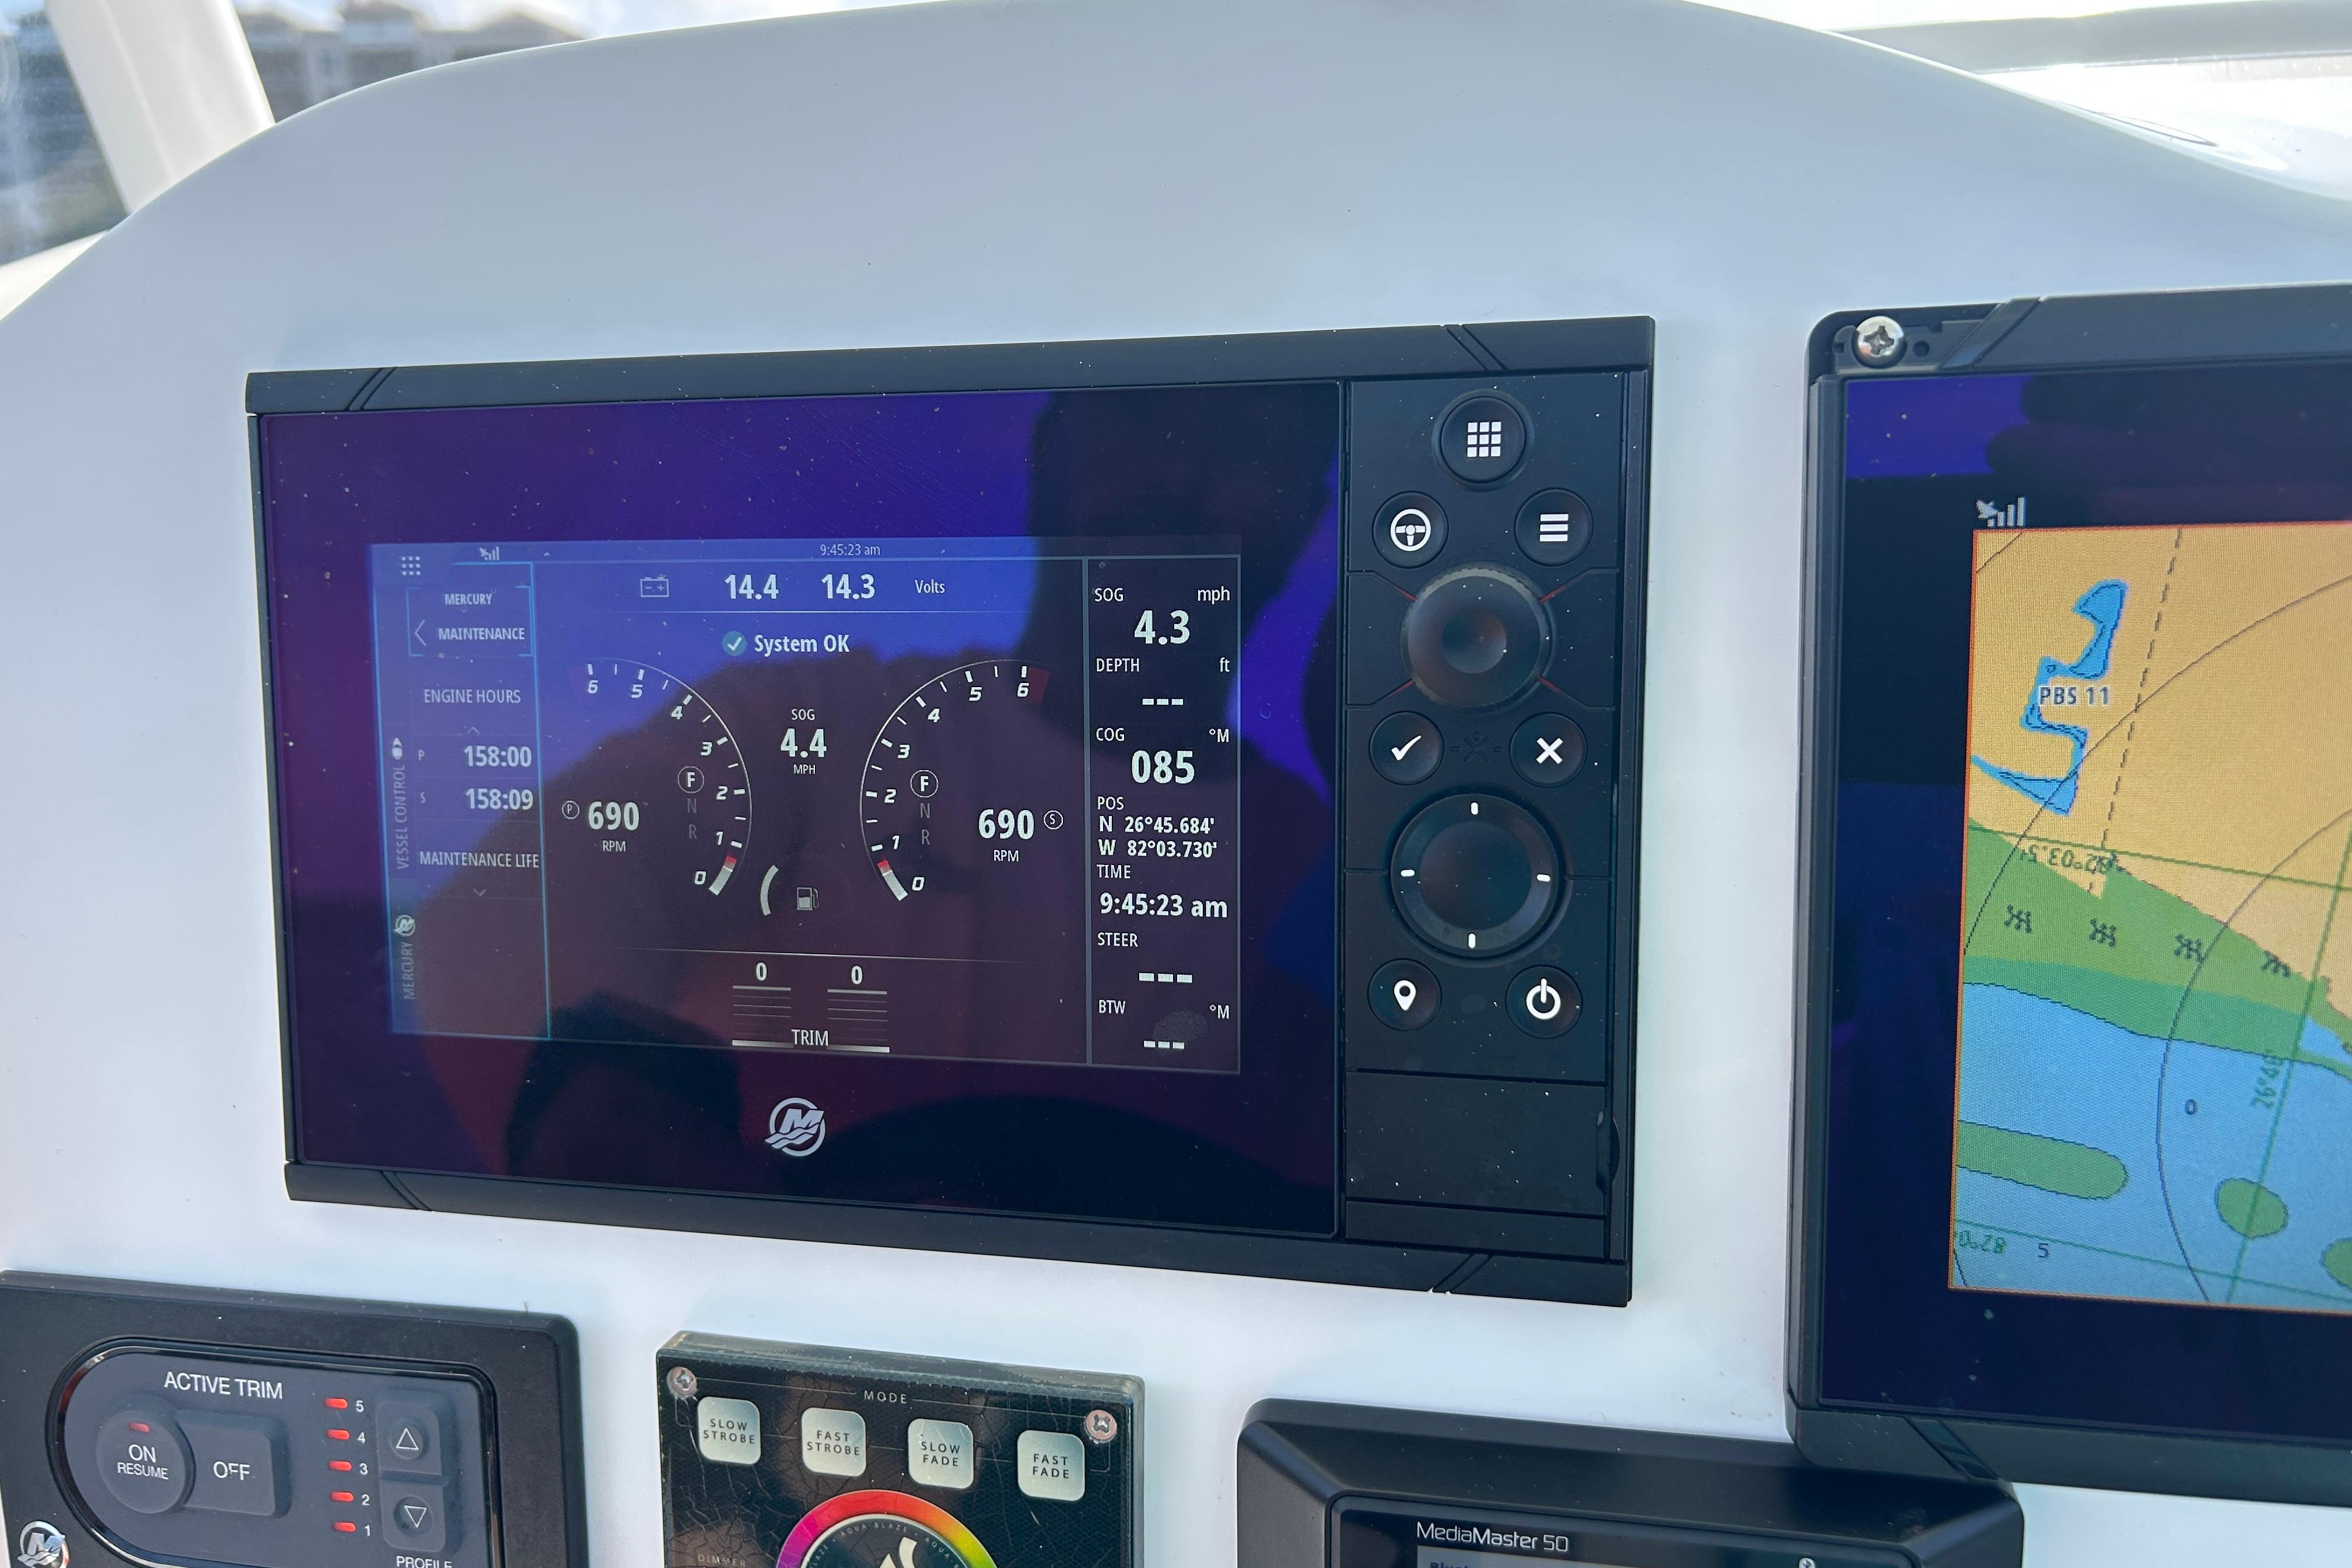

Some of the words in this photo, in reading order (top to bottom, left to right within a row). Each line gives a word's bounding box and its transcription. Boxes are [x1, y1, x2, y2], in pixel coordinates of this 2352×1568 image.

[820, 543, 861, 556] 9:45:23
[864, 547, 881, 556] am
[724, 574, 779, 600] 14.4
[821, 574, 876, 600] 14.3
[915, 579, 945, 594] Volts
[444, 593, 492, 605] MERCURY
[1094, 587, 1124, 602] SOG
[1198, 586, 1230, 604] mph
[438, 626, 525, 640] MAINTENANCE
[1134, 610, 1191, 645] 4.3
[754, 635, 818, 657] System
[823, 635, 850, 653] OK
[1096, 658, 1140, 672] DEPTH
[1219, 657, 1230, 673] ft
[588, 680, 598, 694] 6
[631, 684, 642, 698] 5
[970, 687, 982, 701] 5
[1017, 682, 1029, 697] 6
[424, 689, 473, 703] ENGINE
[477, 689, 521, 704] HOURS
[2039, 685, 2077, 706] PBS
[2087, 685, 2110, 706] 11
[671, 706, 683, 719] 4
[792, 709, 815, 720] SOG
[928, 708, 940, 722] 4
[1096, 727, 1125, 742] COG
[1209, 729, 1229, 743] °M
[701, 742, 712, 755] 3
[780, 728, 827, 758] 4.4
[418, 750, 425, 761] P
[464, 746, 532, 767] 158:00
[898, 744, 910, 758] 3
[793, 764, 816, 775] MPH
[1132, 750, 1195, 784] 085
[687, 773, 695, 786] F
[921, 776, 929, 791] F
[393, 765, 407, 823] CONTROL
[420, 792, 426, 804] S
[466, 788, 534, 810] 158:09
[716, 786, 728, 800] 2
[884, 789, 897, 803] 2
[688, 798, 696, 813] N
[921, 803, 930, 818] N
[1097, 796, 1124, 810] POS
[588, 801, 639, 831] 690
[978, 808, 1034, 839] 690
[689, 824, 697, 839] R
[1099, 816, 1112, 832] N
[1125, 816, 1214, 834] 26°45.684'
[715, 831, 723, 845] 1
[891, 835, 900, 849] 1
[922, 830, 930, 845] R
[396, 827, 410, 869] VESSEL
[602, 840, 626, 852] RPM
[1098, 839, 1116, 856] W
[1127, 840, 1217, 858] 82°03.730'
[419, 850, 512, 867] MAINTENANCE
[515, 853, 539, 867] LIFE
[993, 849, 1019, 862] RPM
[694, 871, 706, 885] 0
[1097, 864, 1130, 879] TIME
[912, 877, 925, 891] 0
[1100, 892, 1184, 916] 9:45:23
[1191, 900, 1227, 918] am
[1097, 932, 1138, 947] STEER
[401, 941, 416, 999] MERCURY
[755, 962, 767, 981] 0
[851, 965, 863, 985] 0
[1098, 1000, 1126, 1014] BTW
[1209, 1005, 1230, 1019] °M
[792, 1029, 829, 1046] TRIM
[2185, 1100, 2197, 1115] 0
[2038, 1242, 2049, 1258] 5
[164, 1371, 231, 1396] ACTIVE
[235, 1378, 284, 1399] TRIM
[863, 1390, 908, 1404] MODE
[355, 1401, 365, 1412] 5
[710, 1419, 747, 1432] SLOW
[357, 1432, 366, 1443] 4
[703, 1429, 755, 1444] STROBE
[817, 1430, 850, 1443] FAST
[128, 1444, 156, 1463] ON
[807, 1442, 860, 1456] STROBE
[921, 1441, 960, 1455] SLOW
[923, 1454, 960, 1468] FADE
[1033, 1453, 1069, 1467] FAST
[117, 1461, 169, 1480] RESUME
[213, 1461, 250, 1480] OFF
[359, 1463, 368, 1475] 3
[1032, 1465, 1070, 1479] FADE
[362, 1493, 370, 1506] 2
[365, 1524, 370, 1536] 1
[841, 1524, 867, 1537] AQUA
[875, 1522, 907, 1532] BLAZE
[1417, 1521, 1538, 1549] MediaMaster
[1543, 1534, 1569, 1552] 50
[925, 1536, 950, 1560] AQUA
[396, 1555, 453, 1568] PROFILE
[698, 1554, 746, 1567] DIMMER
